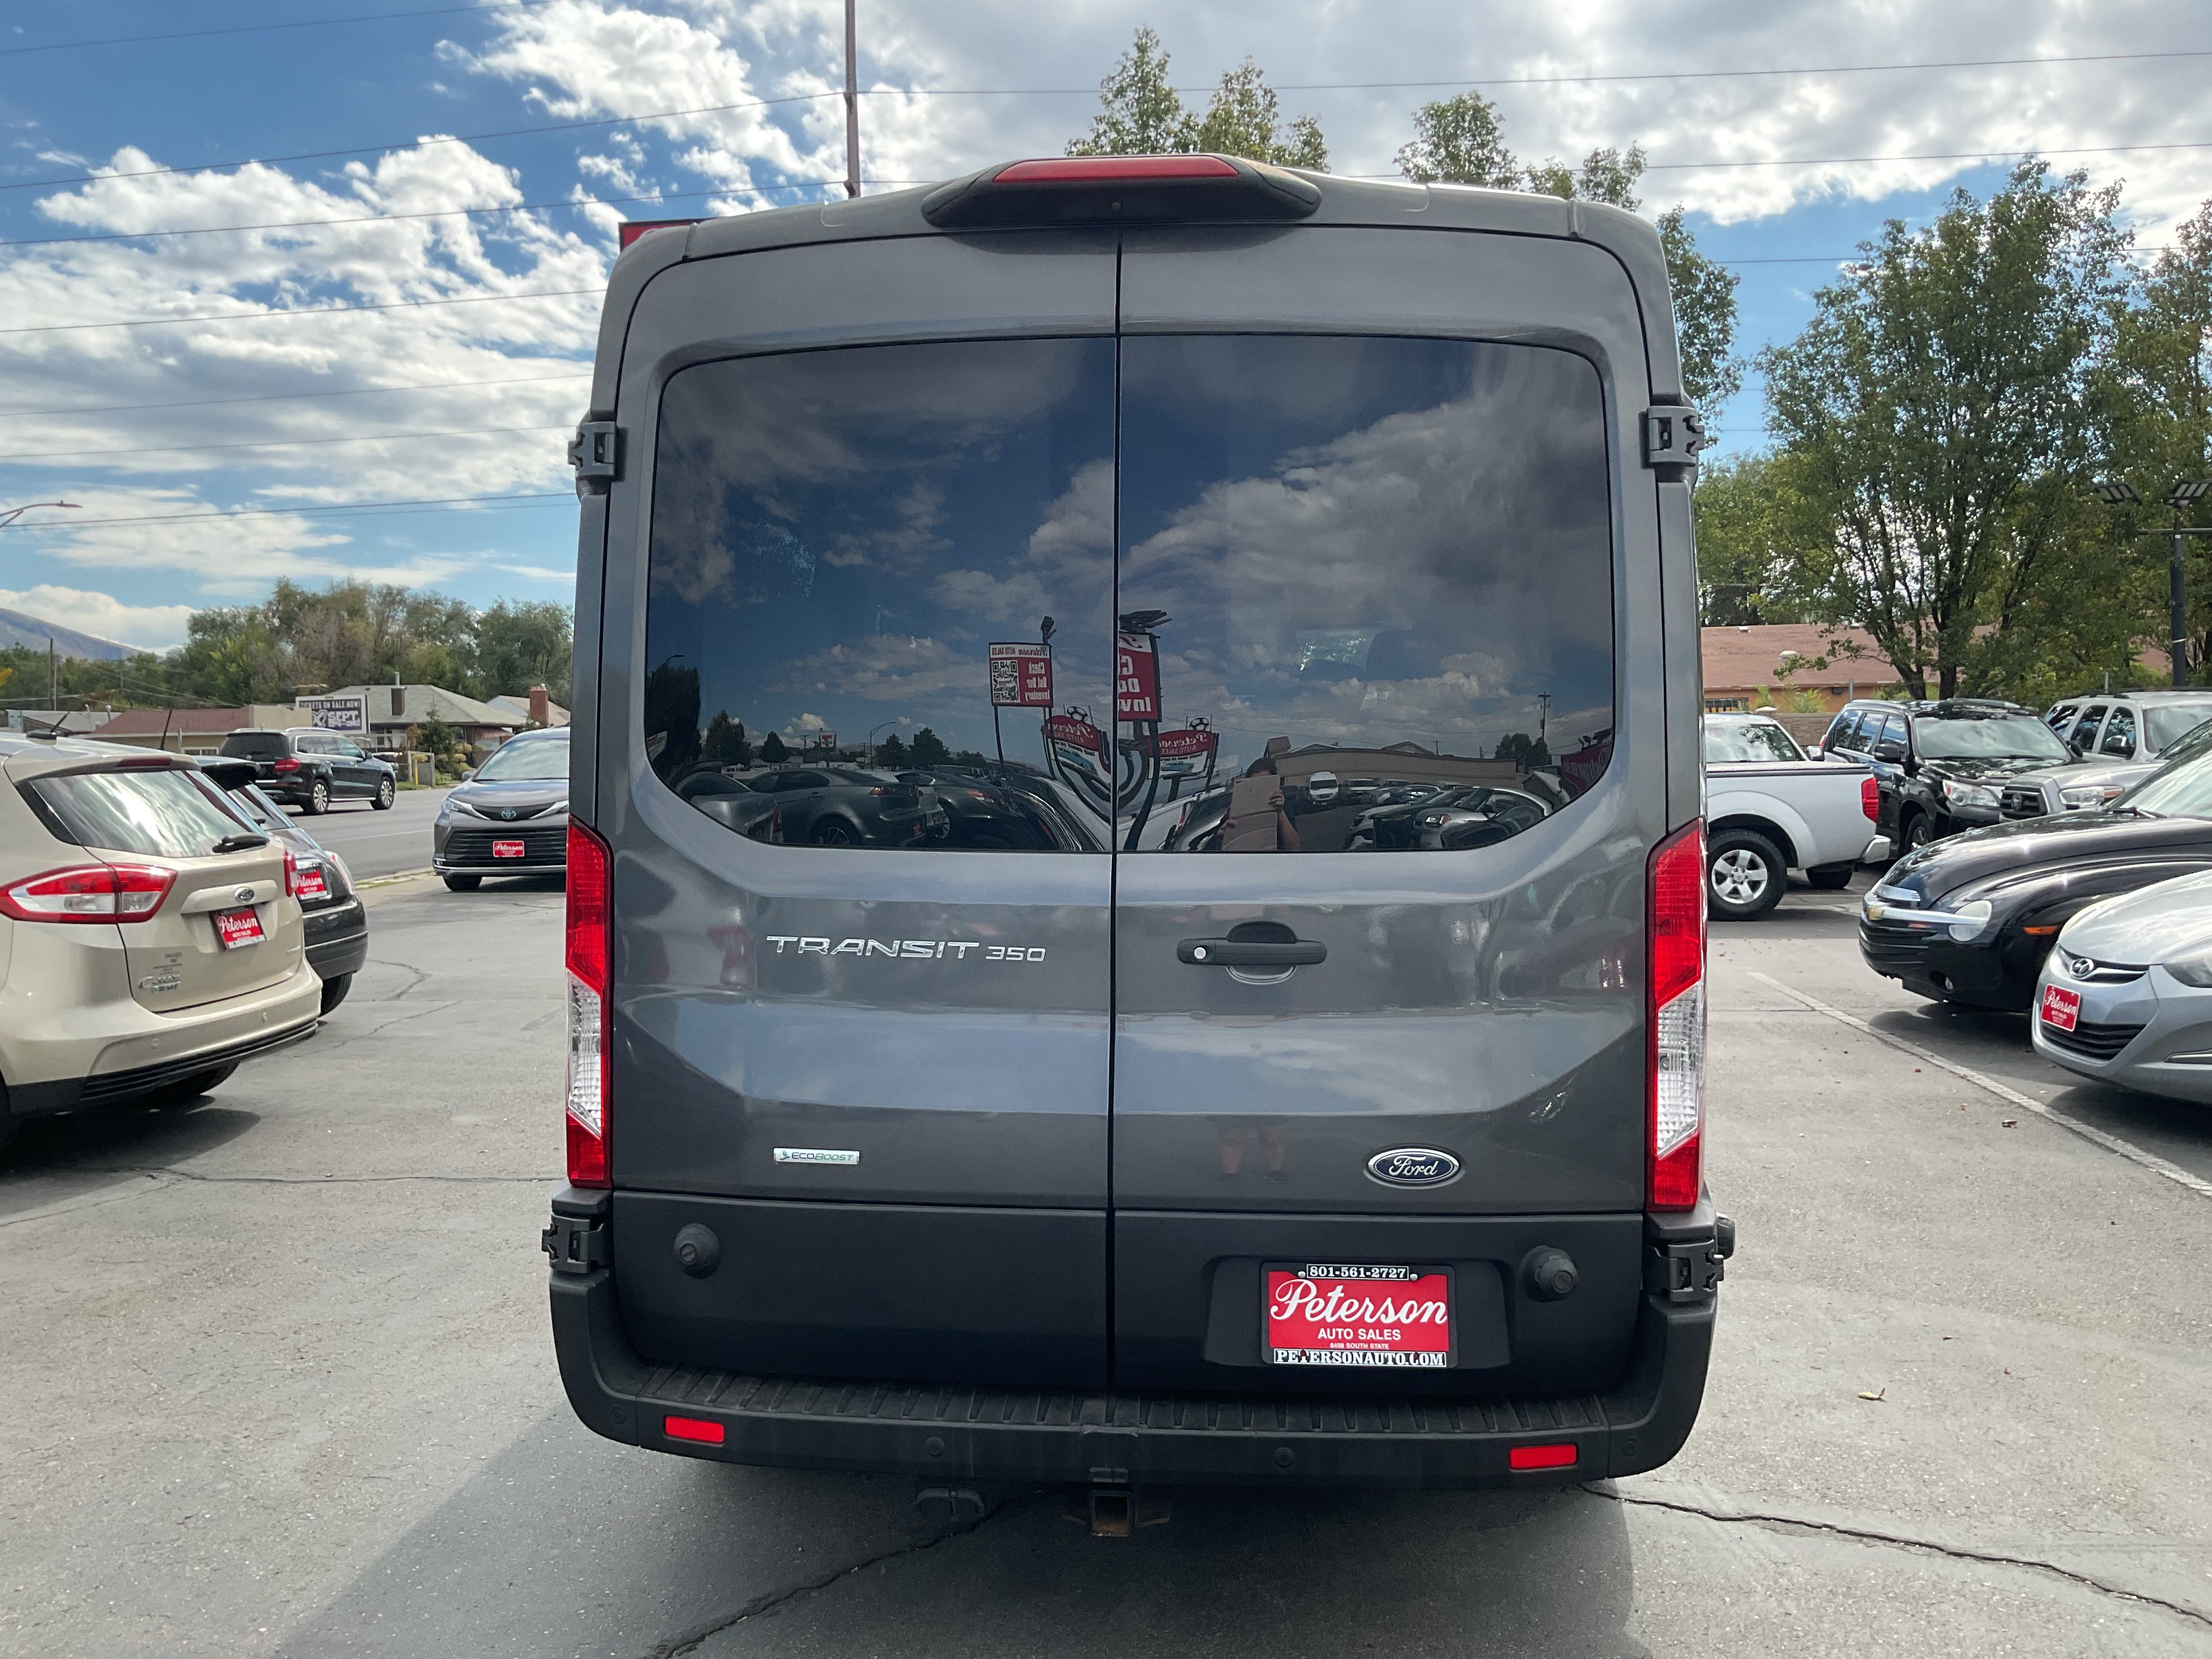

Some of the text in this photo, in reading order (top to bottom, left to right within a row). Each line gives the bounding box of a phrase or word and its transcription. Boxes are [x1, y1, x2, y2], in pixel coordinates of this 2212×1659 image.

[217, 916, 258, 933] Peterson
[766, 936, 1046, 961] TRANSIT 350
[2045, 990, 2077, 1015] Peterson
[792, 1152, 854, 1161] ECOBOOST
[1389, 1155, 1439, 1176] Ford
[1310, 1266, 1406, 1279] 801-561-2727
[1270, 1279, 1448, 1324] Peterson
[1318, 1328, 1401, 1340] AUTO SALES
